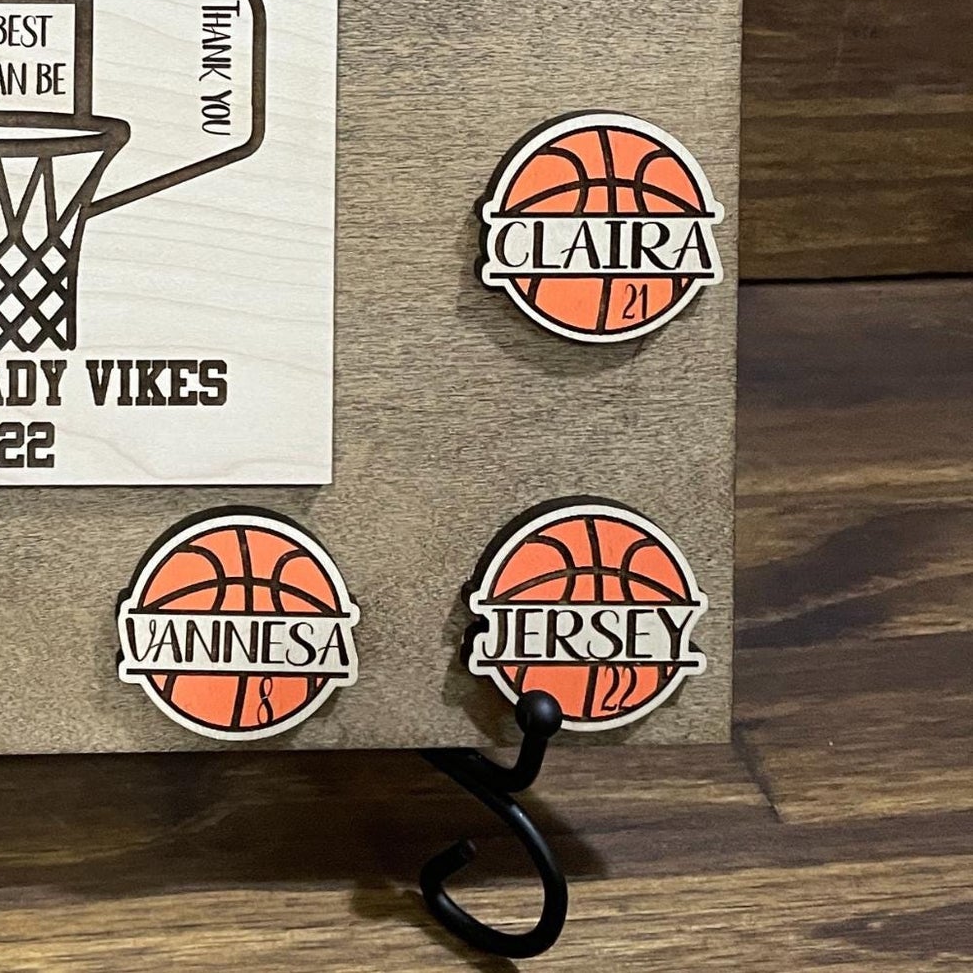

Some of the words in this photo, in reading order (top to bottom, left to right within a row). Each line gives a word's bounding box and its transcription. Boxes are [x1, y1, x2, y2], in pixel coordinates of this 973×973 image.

[200, 0, 241, 82] THANK
[36, 60, 67, 96] BE
[200, 89, 232, 136] YOU
[494, 220, 712, 271] CLAIRA
[621, 283, 649, 320] 21
[85, 359, 228, 407] VIKES
[125, 617, 350, 667] VANNESA
[482, 607, 695, 660] JERSEY
[257, 677, 275, 725] 8
[600, 665, 638, 713] 22
